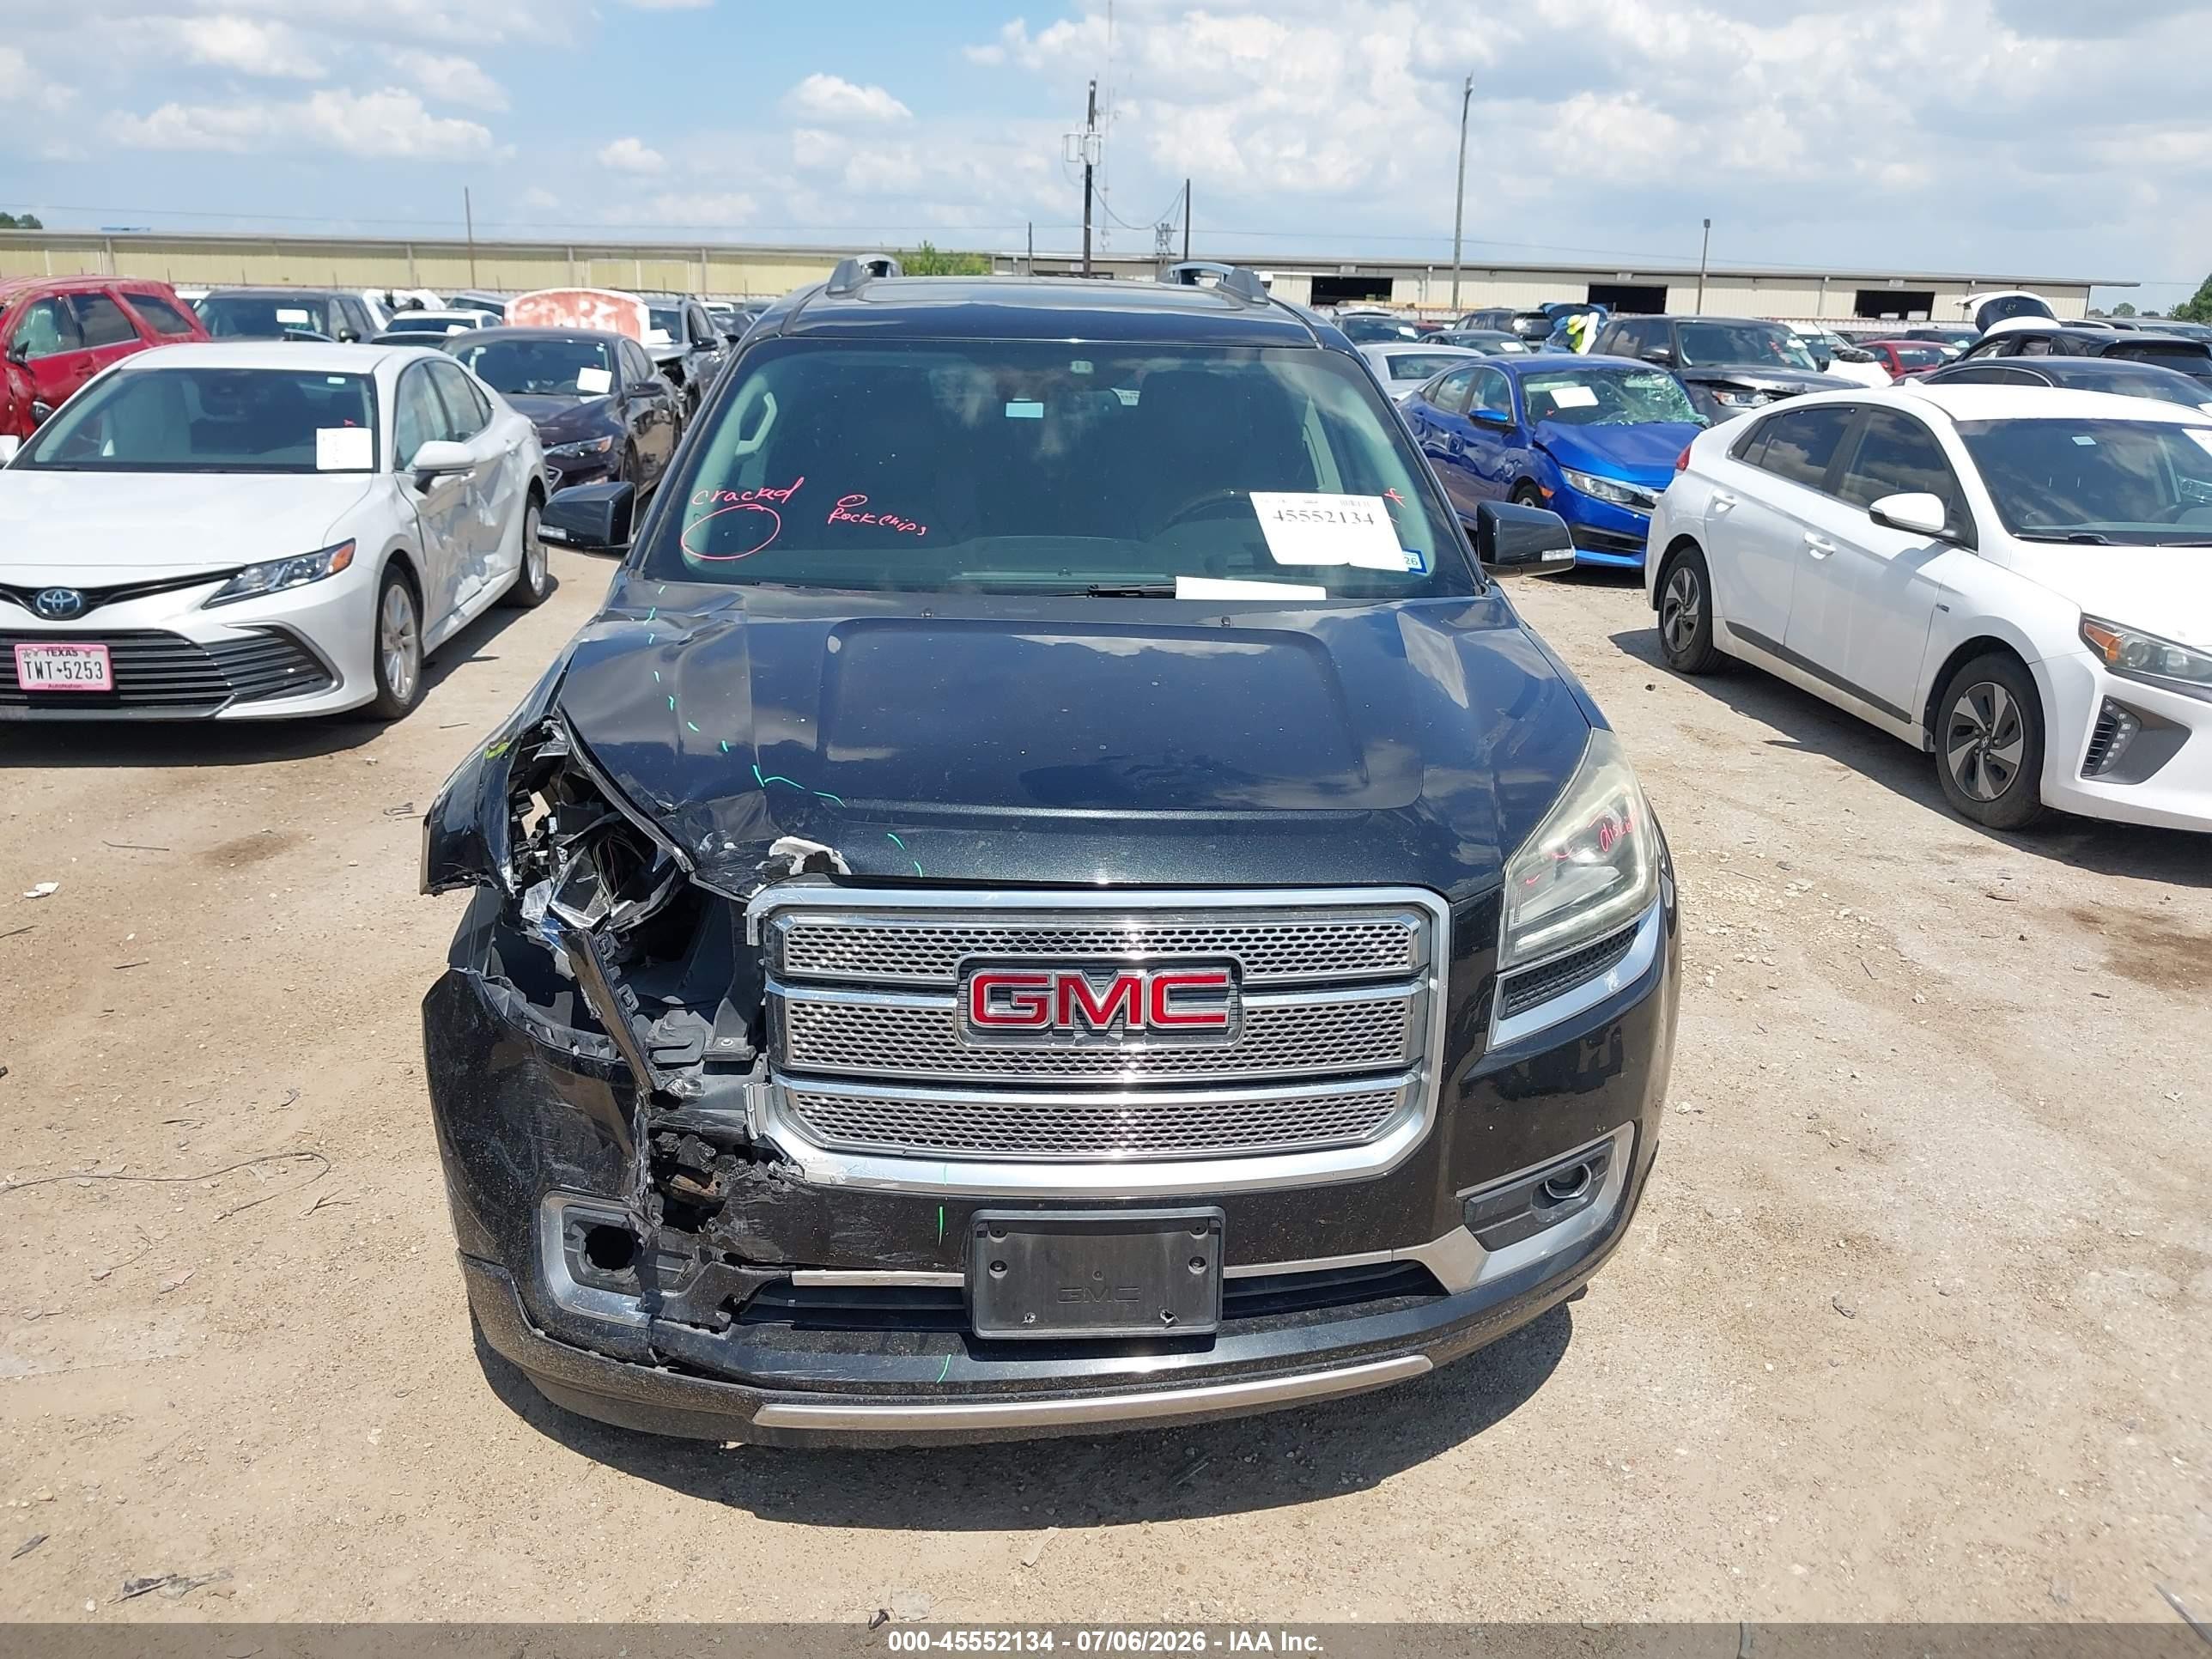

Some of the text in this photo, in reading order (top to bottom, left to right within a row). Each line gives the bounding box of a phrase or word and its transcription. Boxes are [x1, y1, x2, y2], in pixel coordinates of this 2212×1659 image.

[1273, 509, 1374, 526] 45552134
[968, 969, 1231, 1030] GMC
[1057, 1286, 1140, 1304] GMC
